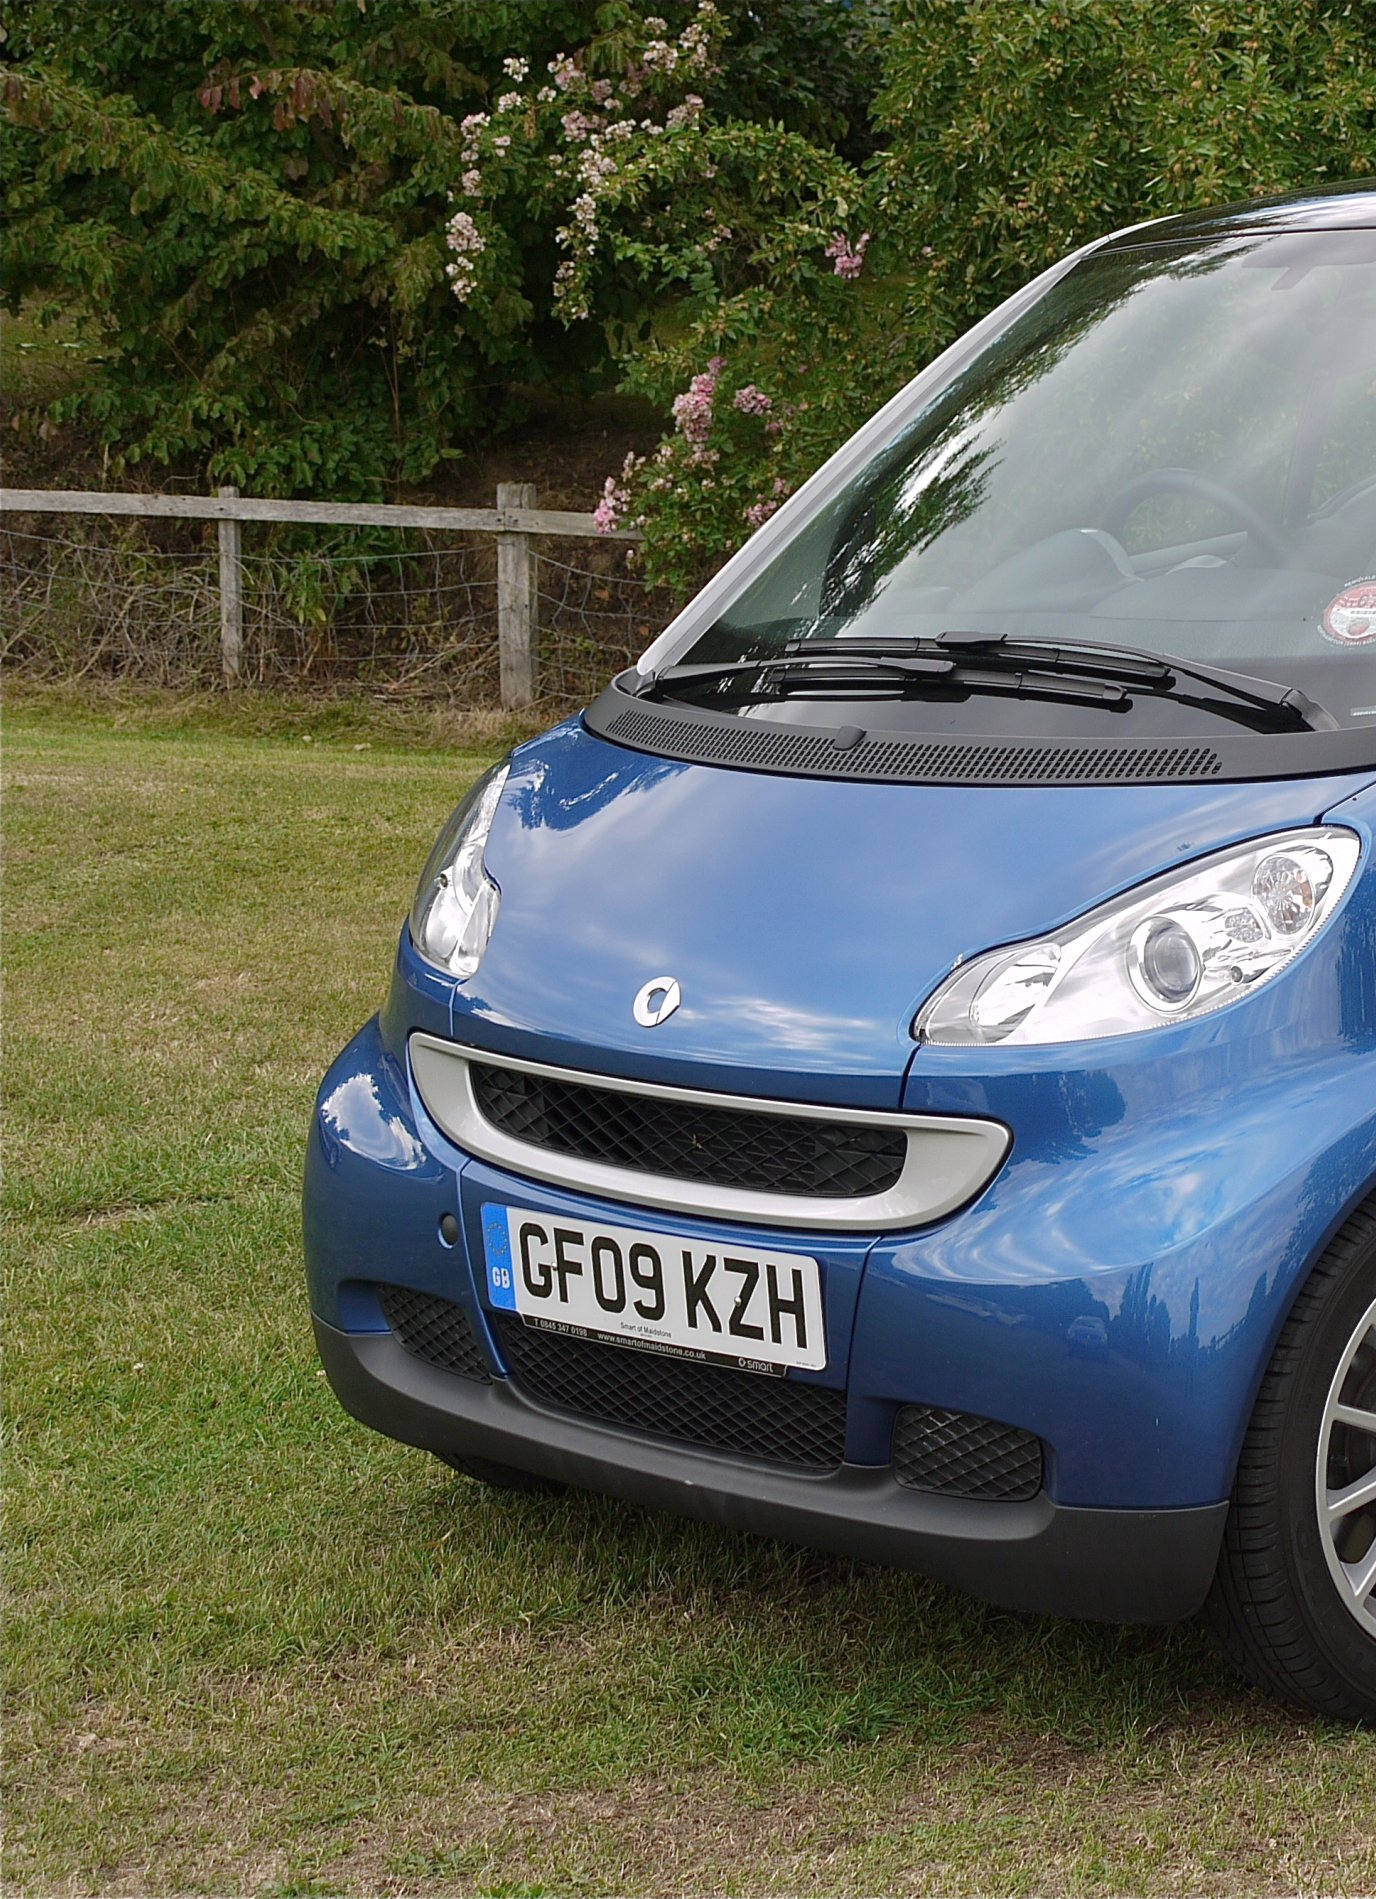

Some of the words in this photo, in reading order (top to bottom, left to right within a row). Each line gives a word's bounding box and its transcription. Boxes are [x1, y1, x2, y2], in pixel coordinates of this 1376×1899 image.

[492, 1266, 511, 1289] GB
[518, 1221, 665, 1322] GF09
[681, 1250, 808, 1350] KZH
[534, 1317, 540, 1327] T
[540, 1319, 557, 1330] 0845
[620, 1321, 636, 1331] Smart
[637, 1324, 644, 1332] of
[644, 1326, 672, 1338] Maidstone
[597, 1332, 707, 1360] www.smartofmaidstone.co.uk
[747, 1359, 774, 1373] smart
